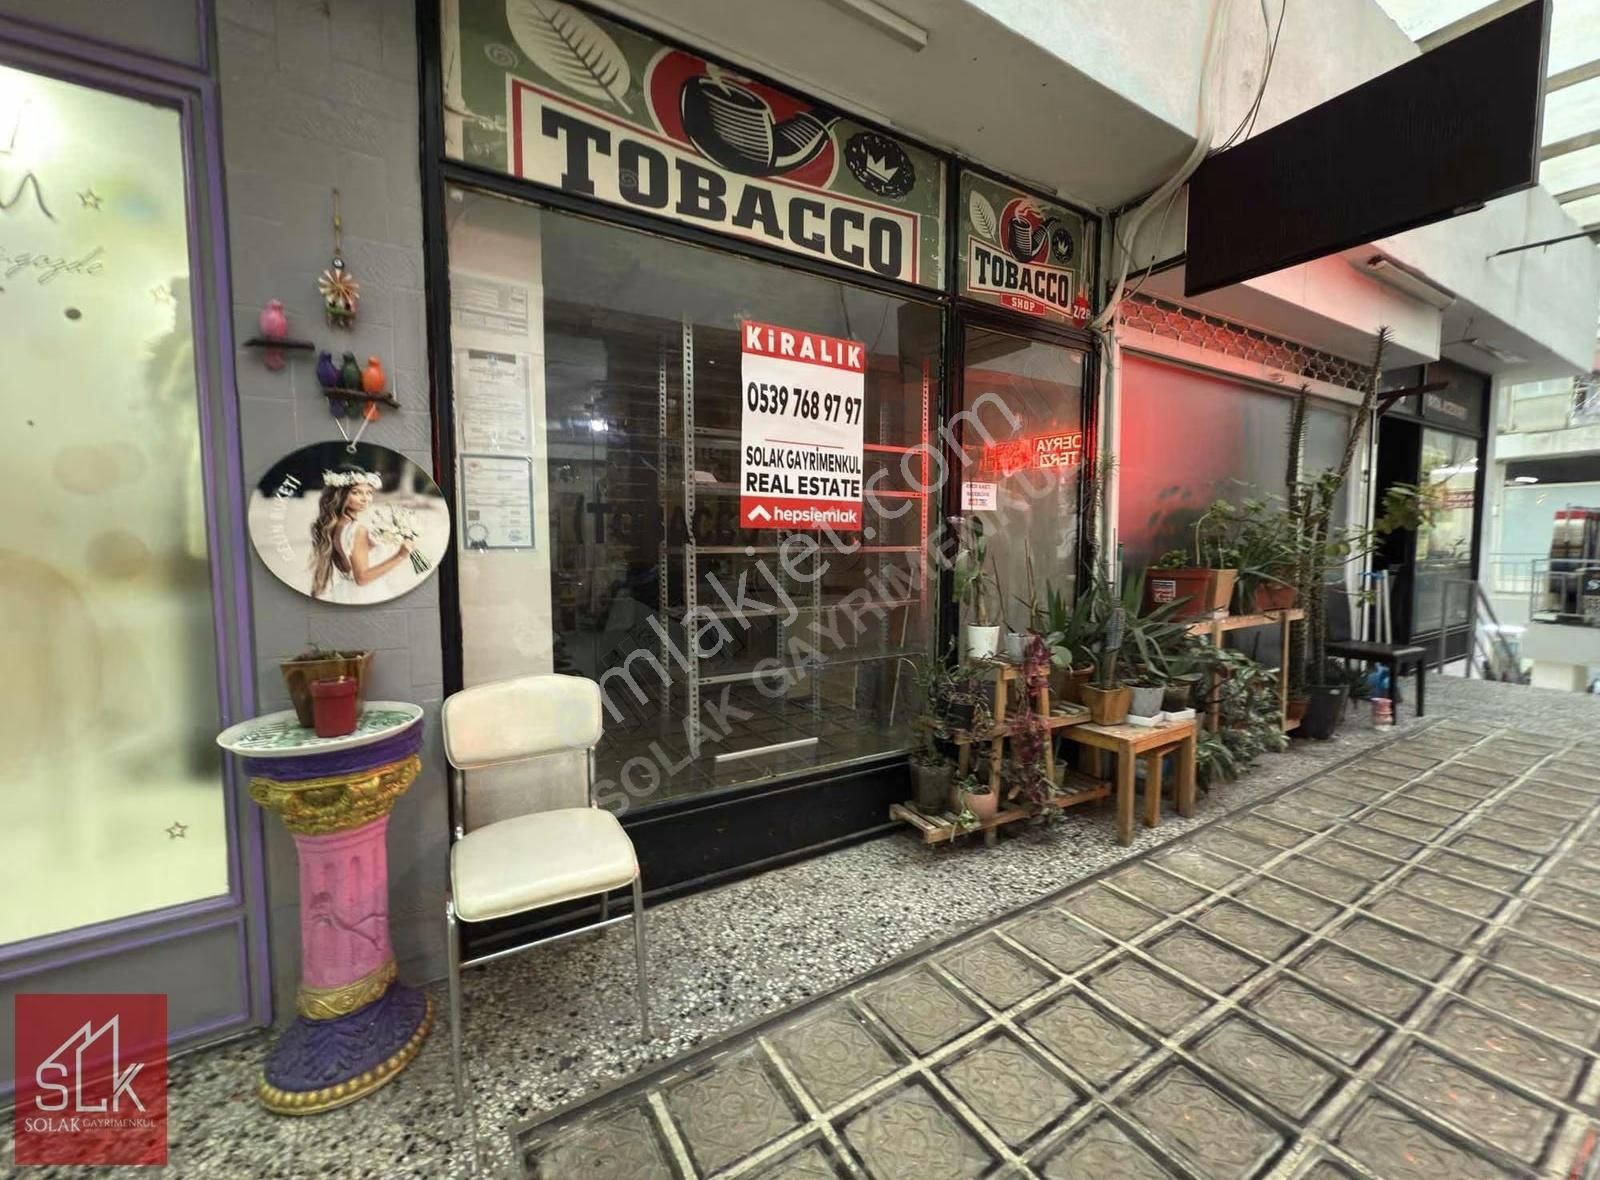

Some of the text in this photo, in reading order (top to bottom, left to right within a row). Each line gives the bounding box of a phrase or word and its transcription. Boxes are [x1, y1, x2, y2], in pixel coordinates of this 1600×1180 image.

[540, 105, 903, 279] TOBACCO
[974, 246, 1069, 309] TOBACCO
[1011, 297, 1036, 312] SHOP
[747, 381, 862, 425] 0539 768 97 97
[745, 446, 861, 474] SOLAK GAYRİMENKUL
[745, 472, 861, 498] REAL ESTATE
[773, 505, 858, 524] hepsiemlak
